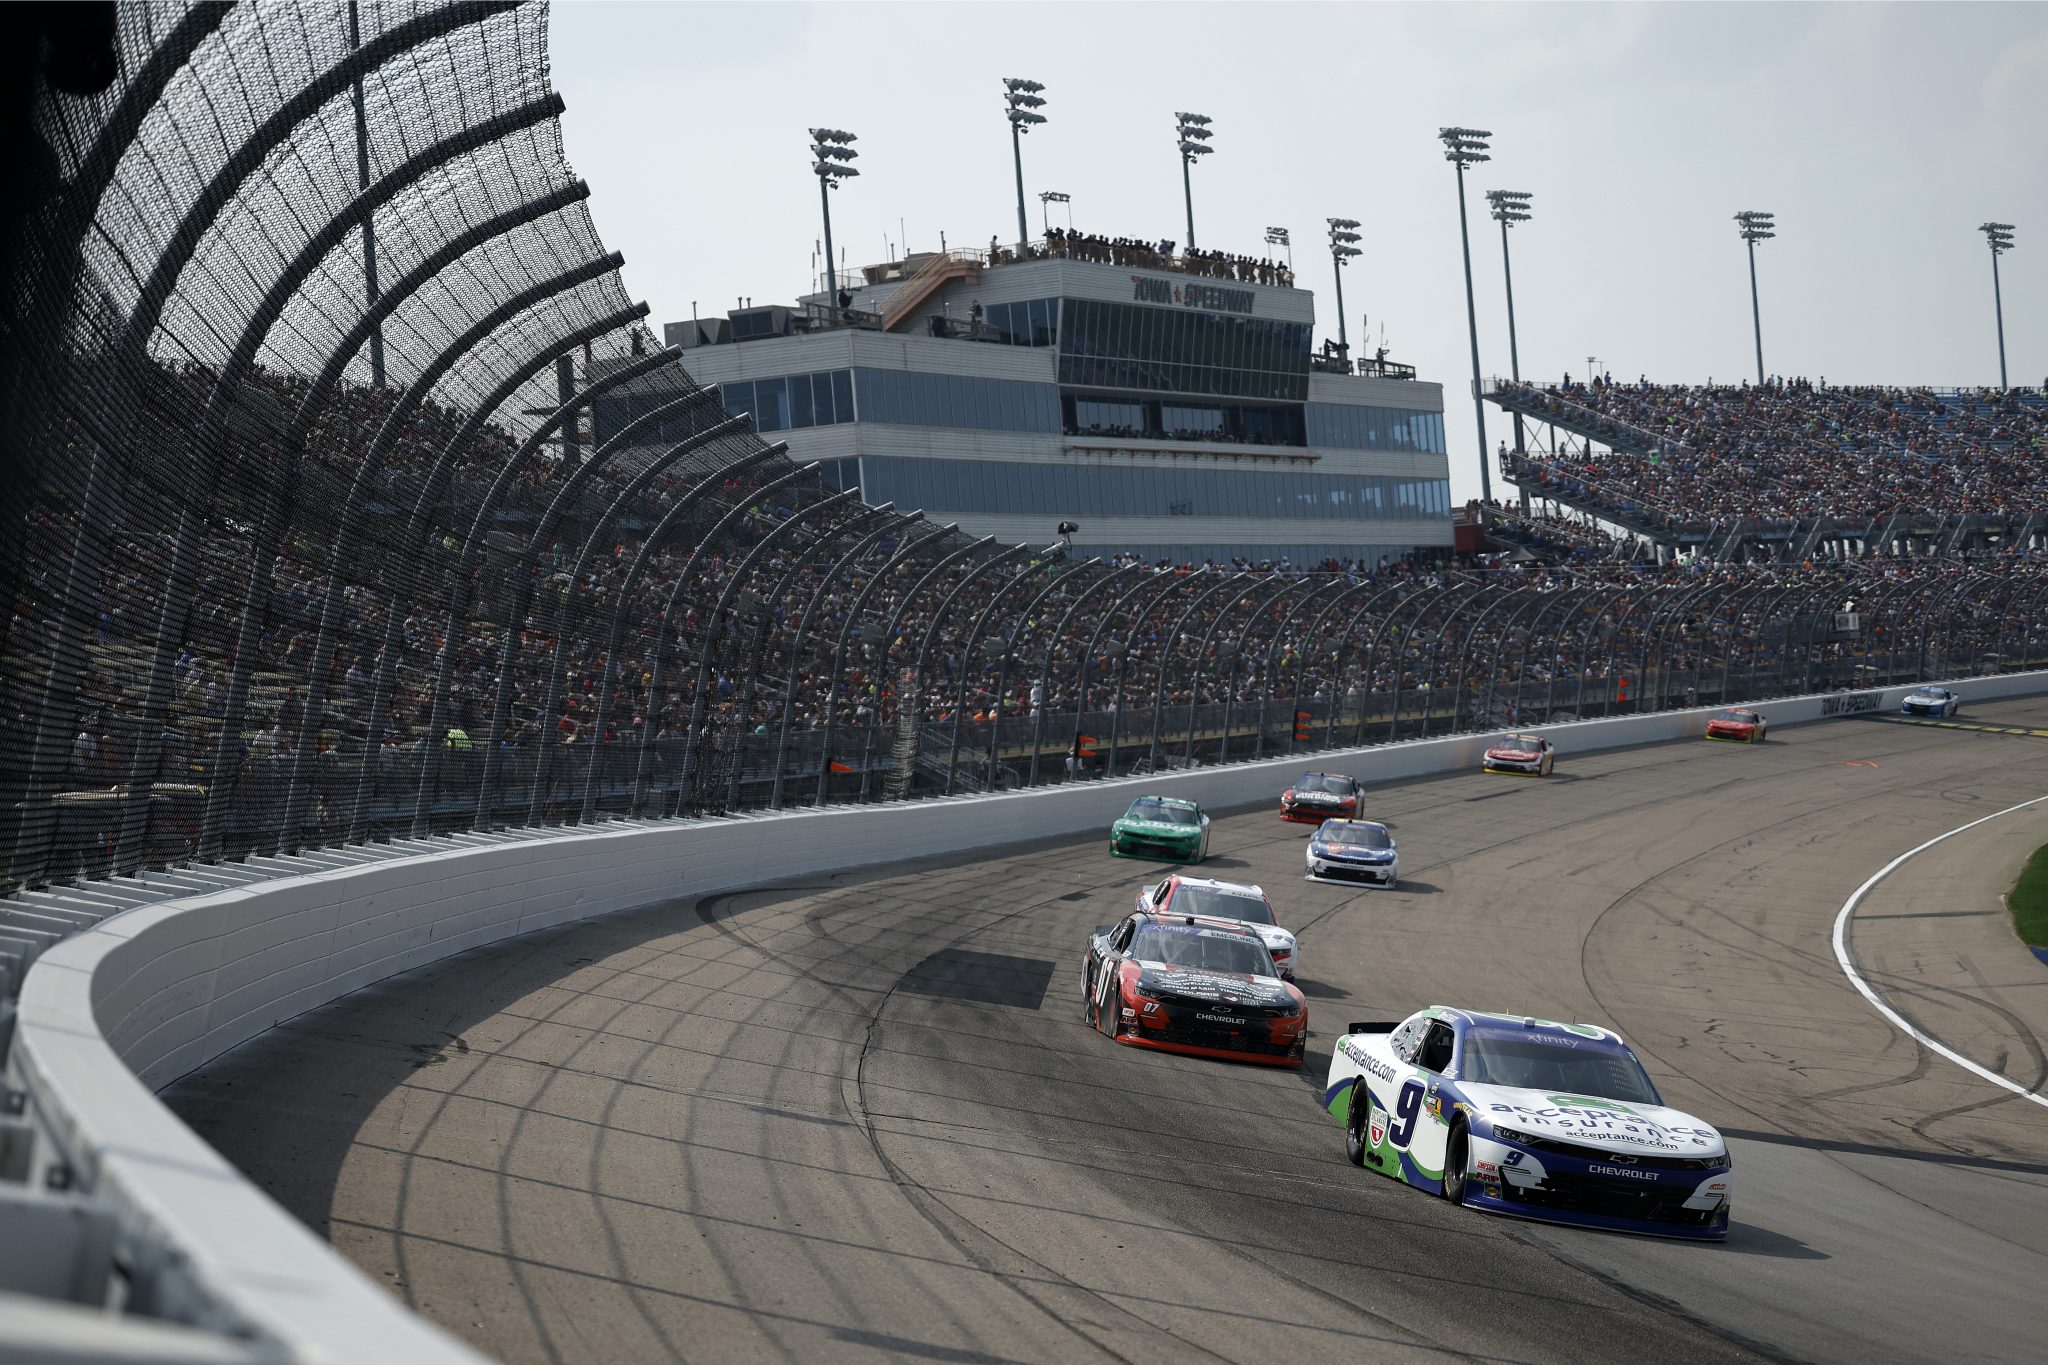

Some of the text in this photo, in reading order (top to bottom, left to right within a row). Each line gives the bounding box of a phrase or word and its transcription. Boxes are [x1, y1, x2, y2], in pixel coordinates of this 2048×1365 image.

[1131, 275, 1255, 314] IOWA SPEEDWAY
[1821, 692, 1884, 716] IOWA SPEEDWAY
[1152, 924, 1255, 944] xfinity EMERLING
[1143, 1002, 1160, 1013] 07
[1196, 1013, 1246, 1025] CHEVROLET
[1527, 1032, 1579, 1049] xfinity
[1344, 1042, 1397, 1084] acceptance.com
[1389, 1079, 1426, 1149] 9
[1490, 1103, 1717, 1138] acceptance
[1518, 1115, 1708, 1146] insurance
[1566, 1130, 1680, 1150] acceptance.com
[1476, 1160, 1498, 1171] SIMPSON
[1503, 1151, 1525, 1166] 9
[1474, 1172, 1499, 1182] ARP
[1589, 1165, 1660, 1181] CHEVROLET
